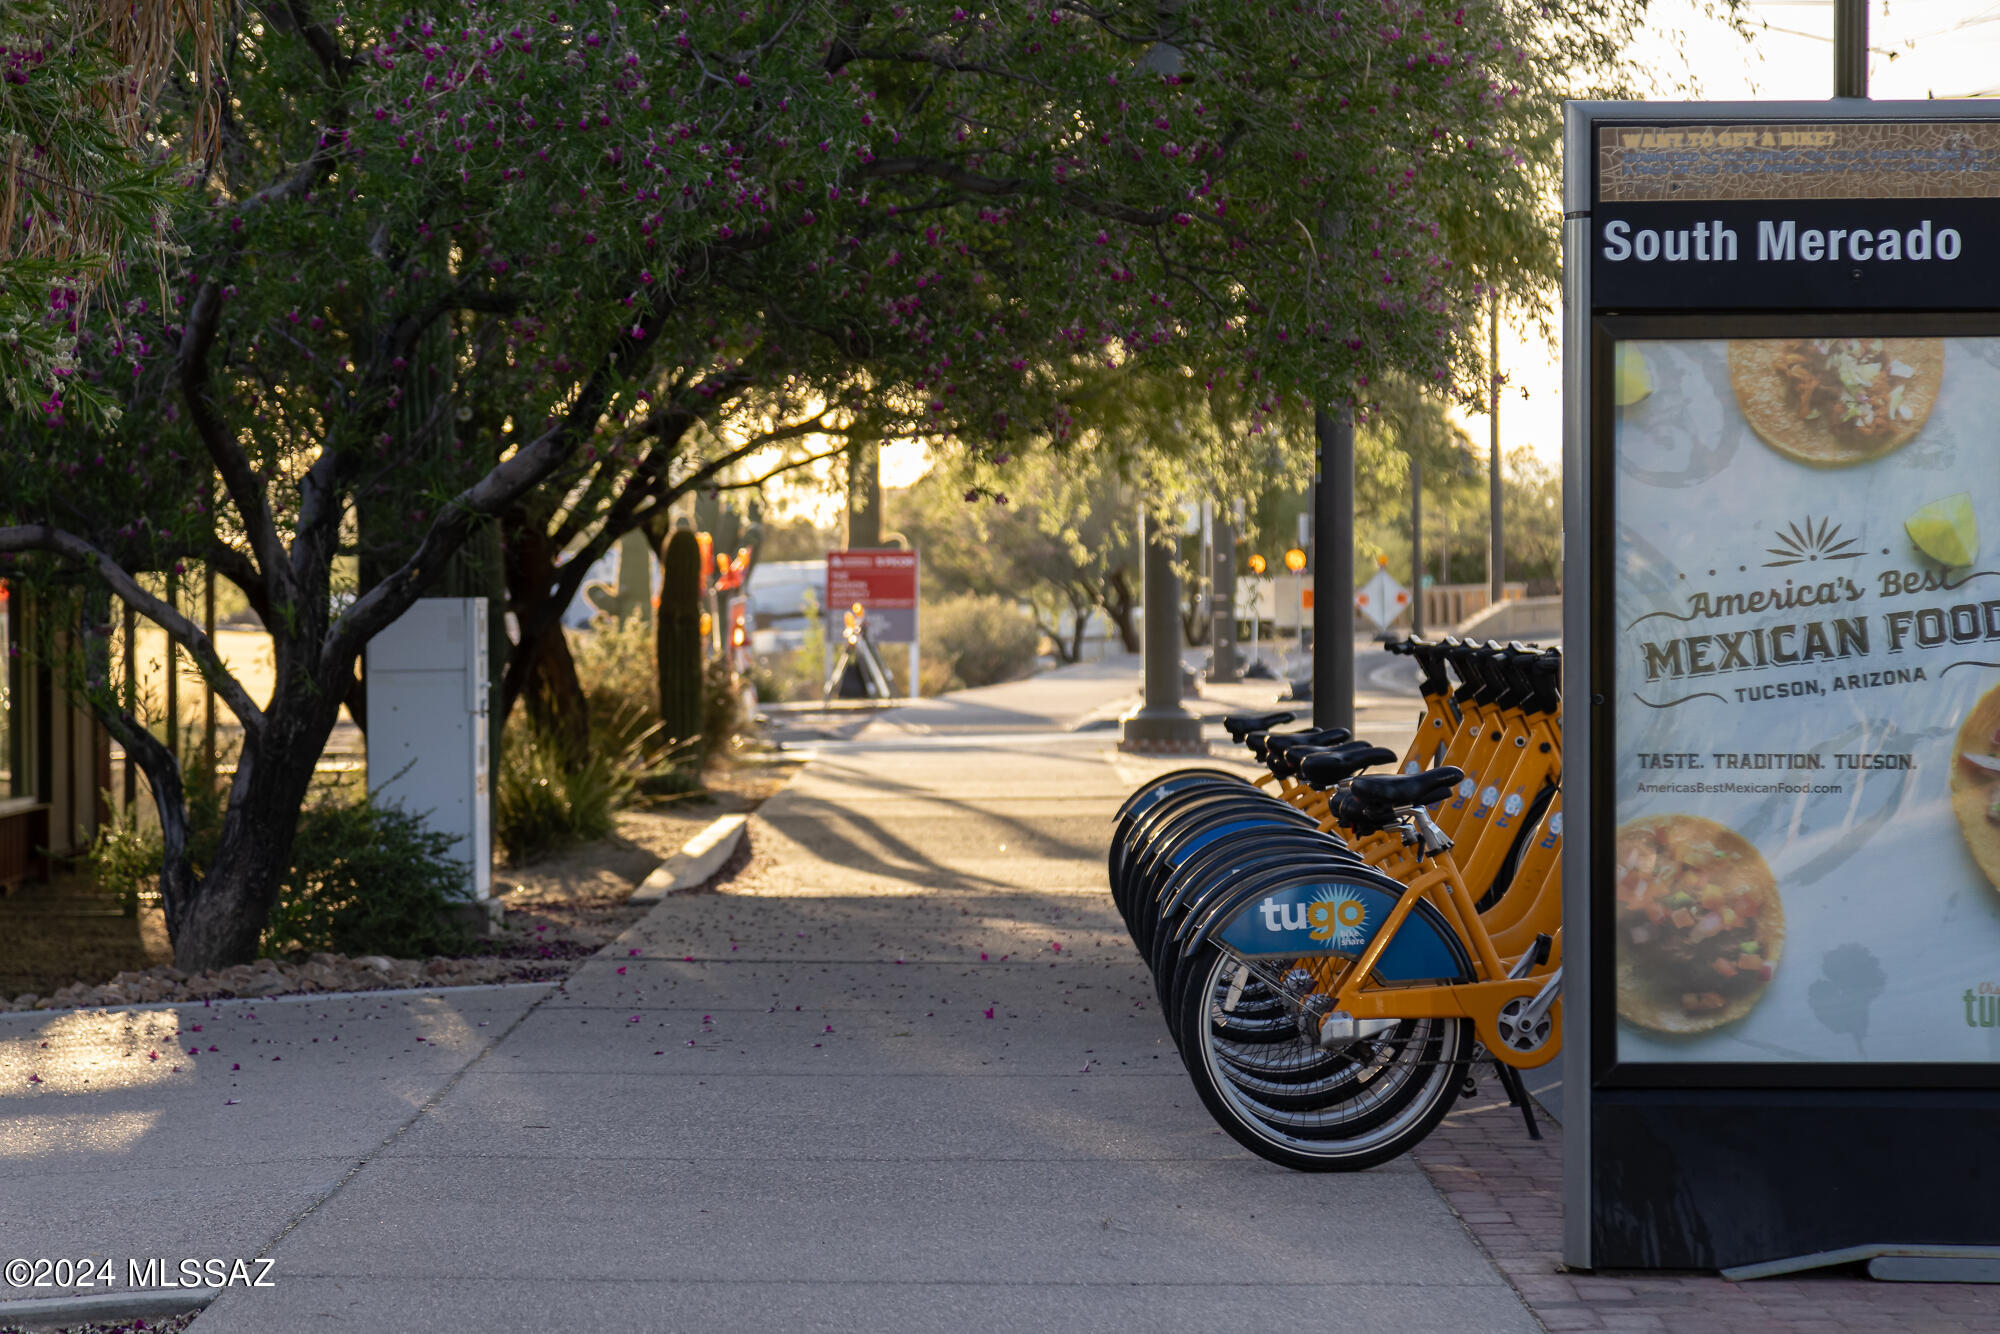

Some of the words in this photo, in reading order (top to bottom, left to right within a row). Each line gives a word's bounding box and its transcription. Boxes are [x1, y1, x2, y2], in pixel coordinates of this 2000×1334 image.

[1622, 133, 1684, 149] WANT
[1687, 132, 1715, 148] TO
[1717, 132, 1757, 147] GET
[1760, 131, 1776, 146] A
[1780, 131, 1836, 146] BIKE?
[1603, 220, 1738, 261] South
[1757, 220, 1962, 261] Mercado
[1687, 576, 1865, 619] America's
[1878, 565, 1955, 598] Best
[1642, 616, 1870, 682] MEXICAN
[1883, 600, 2000, 654] FOOD
[1735, 679, 1826, 702] TUCSON,
[1833, 667, 1927, 691] ARIZONA
[1637, 753, 1704, 769] TASTE.
[1712, 753, 1826, 769] TRADITION.
[1834, 753, 1917, 769] TUCSON.
[1637, 782, 1843, 794] AmericasBestMexicanFood.com
[1260, 898, 1365, 940] tugo
